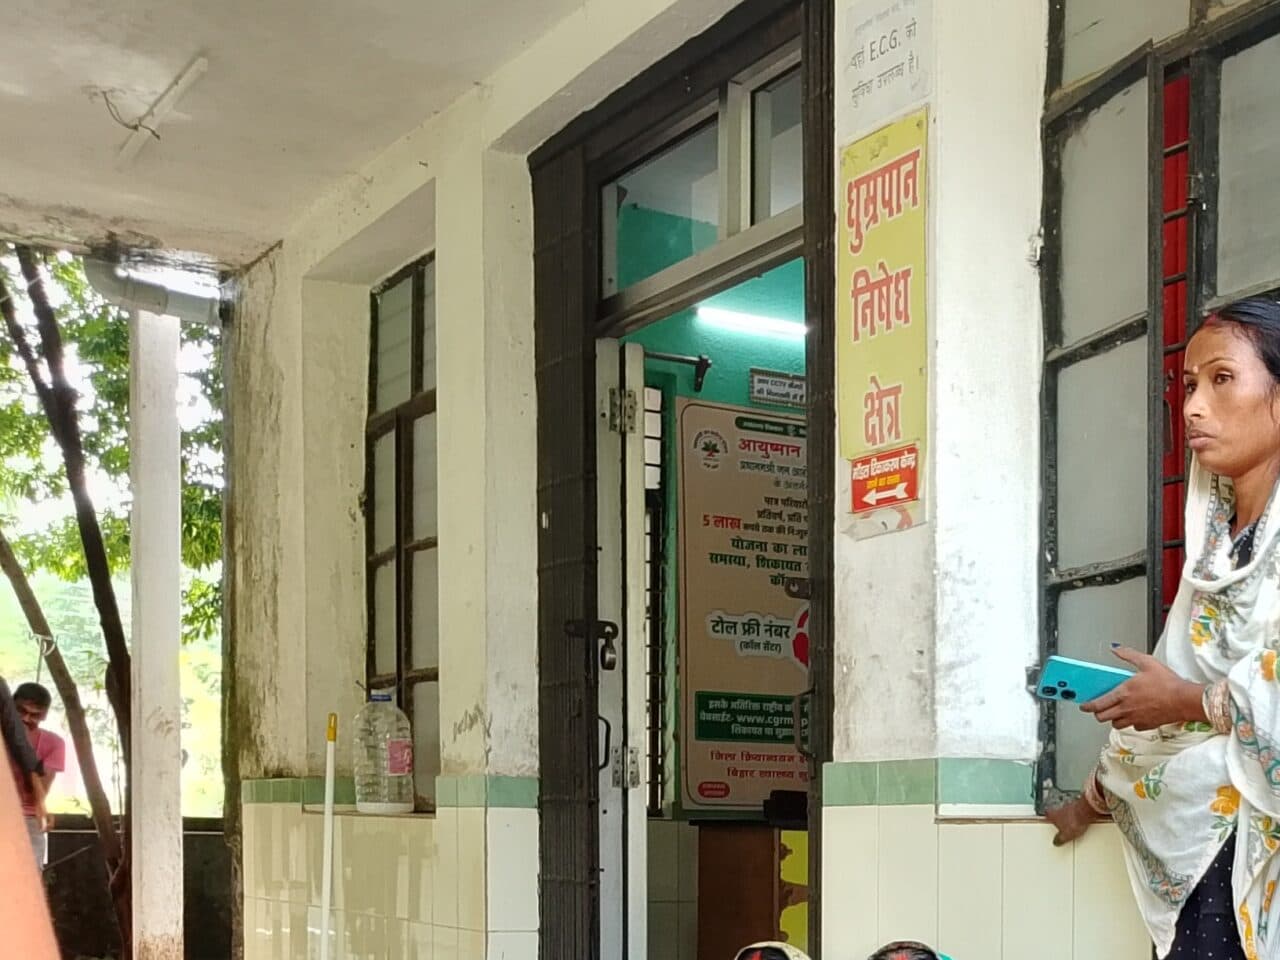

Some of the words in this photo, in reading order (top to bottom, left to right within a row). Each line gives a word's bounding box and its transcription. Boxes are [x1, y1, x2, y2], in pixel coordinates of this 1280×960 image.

[870, 29, 901, 61] E.C.G.
[851, 261, 911, 342] निषेध
[864, 376, 902, 446] क्षेत्र
[738, 438, 802, 459] आयुष्मान
[703, 513, 711, 527] 5
[712, 514, 742, 530] लाख
[730, 535, 768, 552] योजना
[773, 542, 788, 554] का
[792, 544, 808, 556] ला
[755, 554, 801, 572] शिकायत
[711, 615, 739, 636] टोल
[742, 618, 761, 637] फ्री
[764, 620, 792, 640] नंबर
